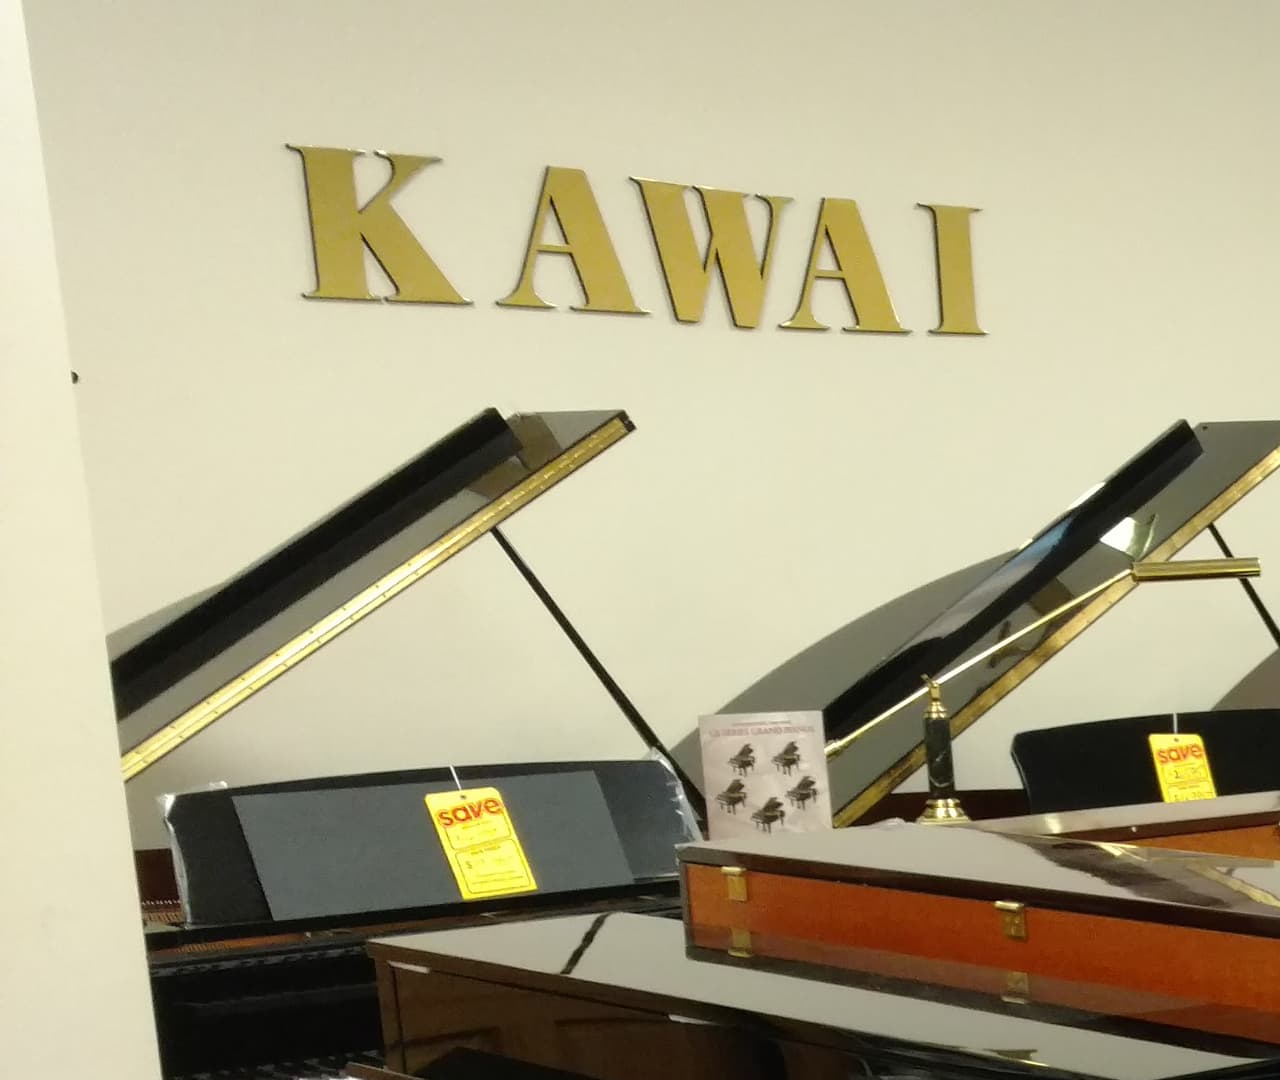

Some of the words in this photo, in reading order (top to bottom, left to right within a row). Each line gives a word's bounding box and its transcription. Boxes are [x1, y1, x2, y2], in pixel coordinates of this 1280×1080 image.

[285, 142, 990, 336] KAWAI
[1157, 744, 1204, 764] save
[437, 798, 504, 828] save
